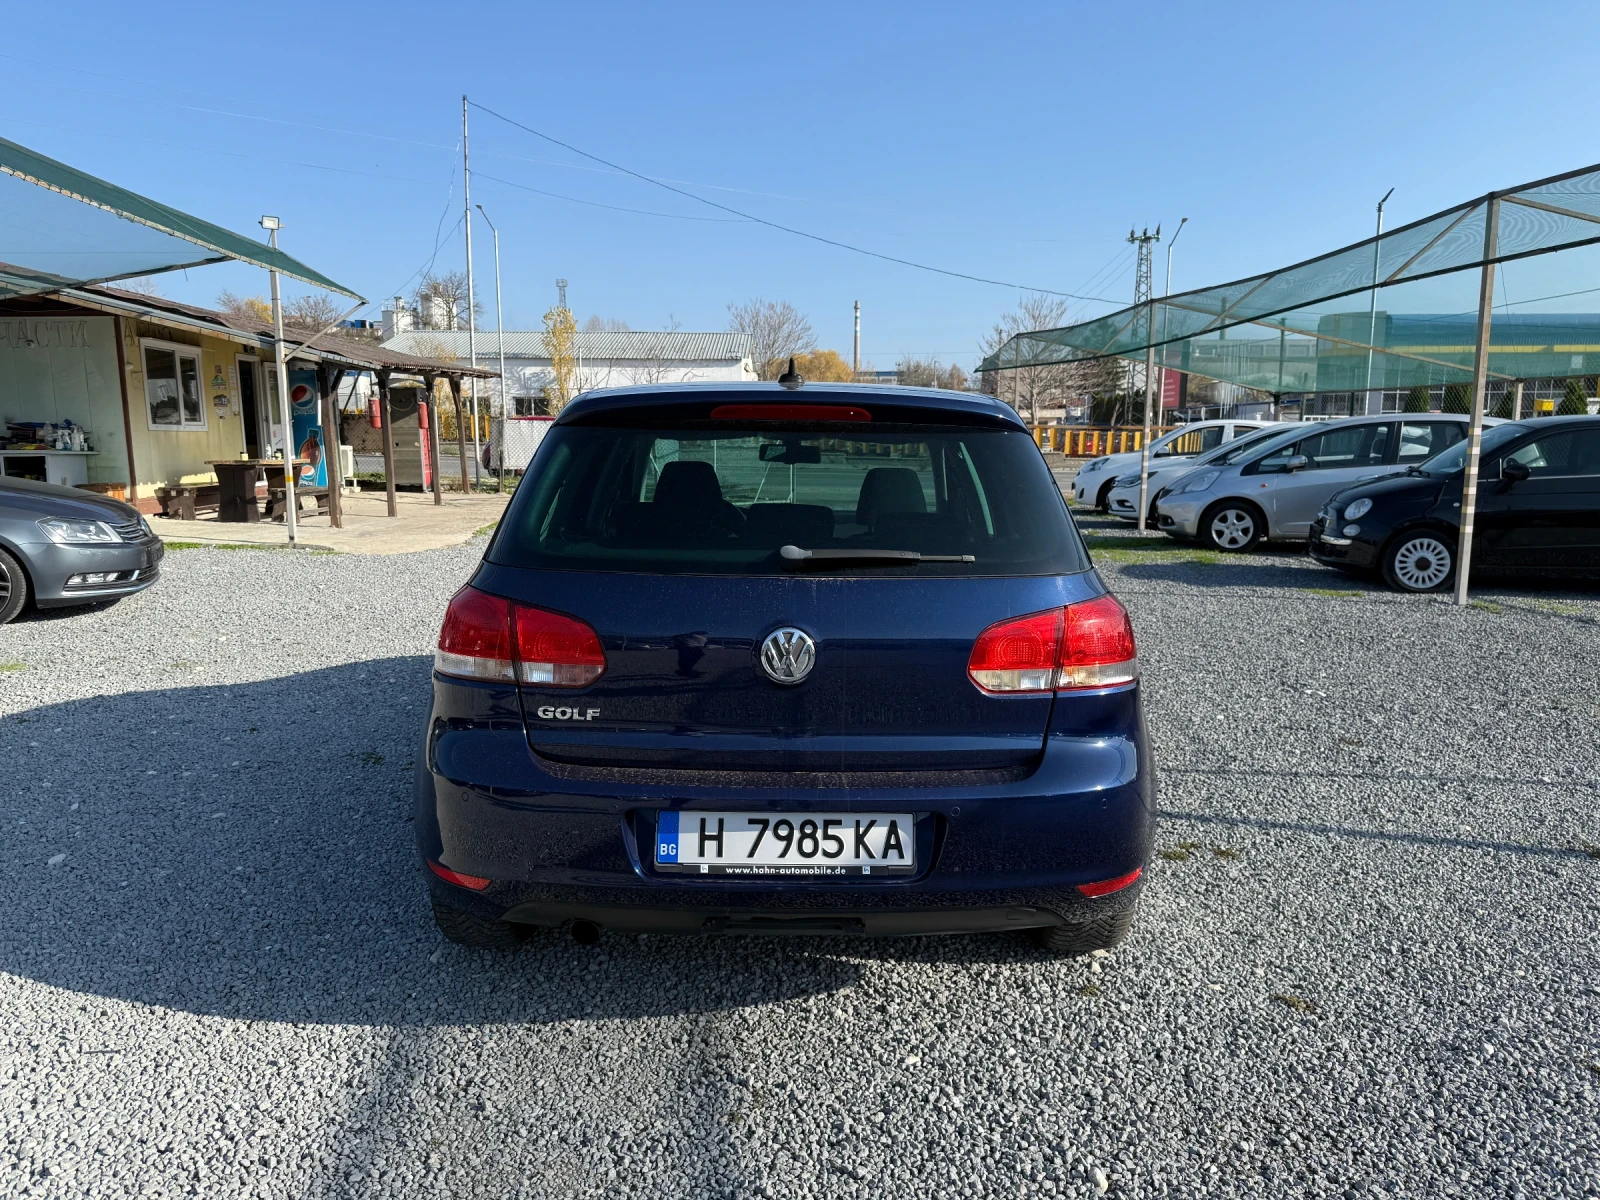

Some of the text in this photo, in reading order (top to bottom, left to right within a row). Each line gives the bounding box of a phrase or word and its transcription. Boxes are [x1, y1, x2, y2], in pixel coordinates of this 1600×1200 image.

[293, 408, 316, 417] pepsi
[537, 705, 601, 721] GOLF
[697, 817, 725, 858] H
[660, 843, 677, 856] BG
[725, 865, 847, 876] www.hahn-automobile.de
